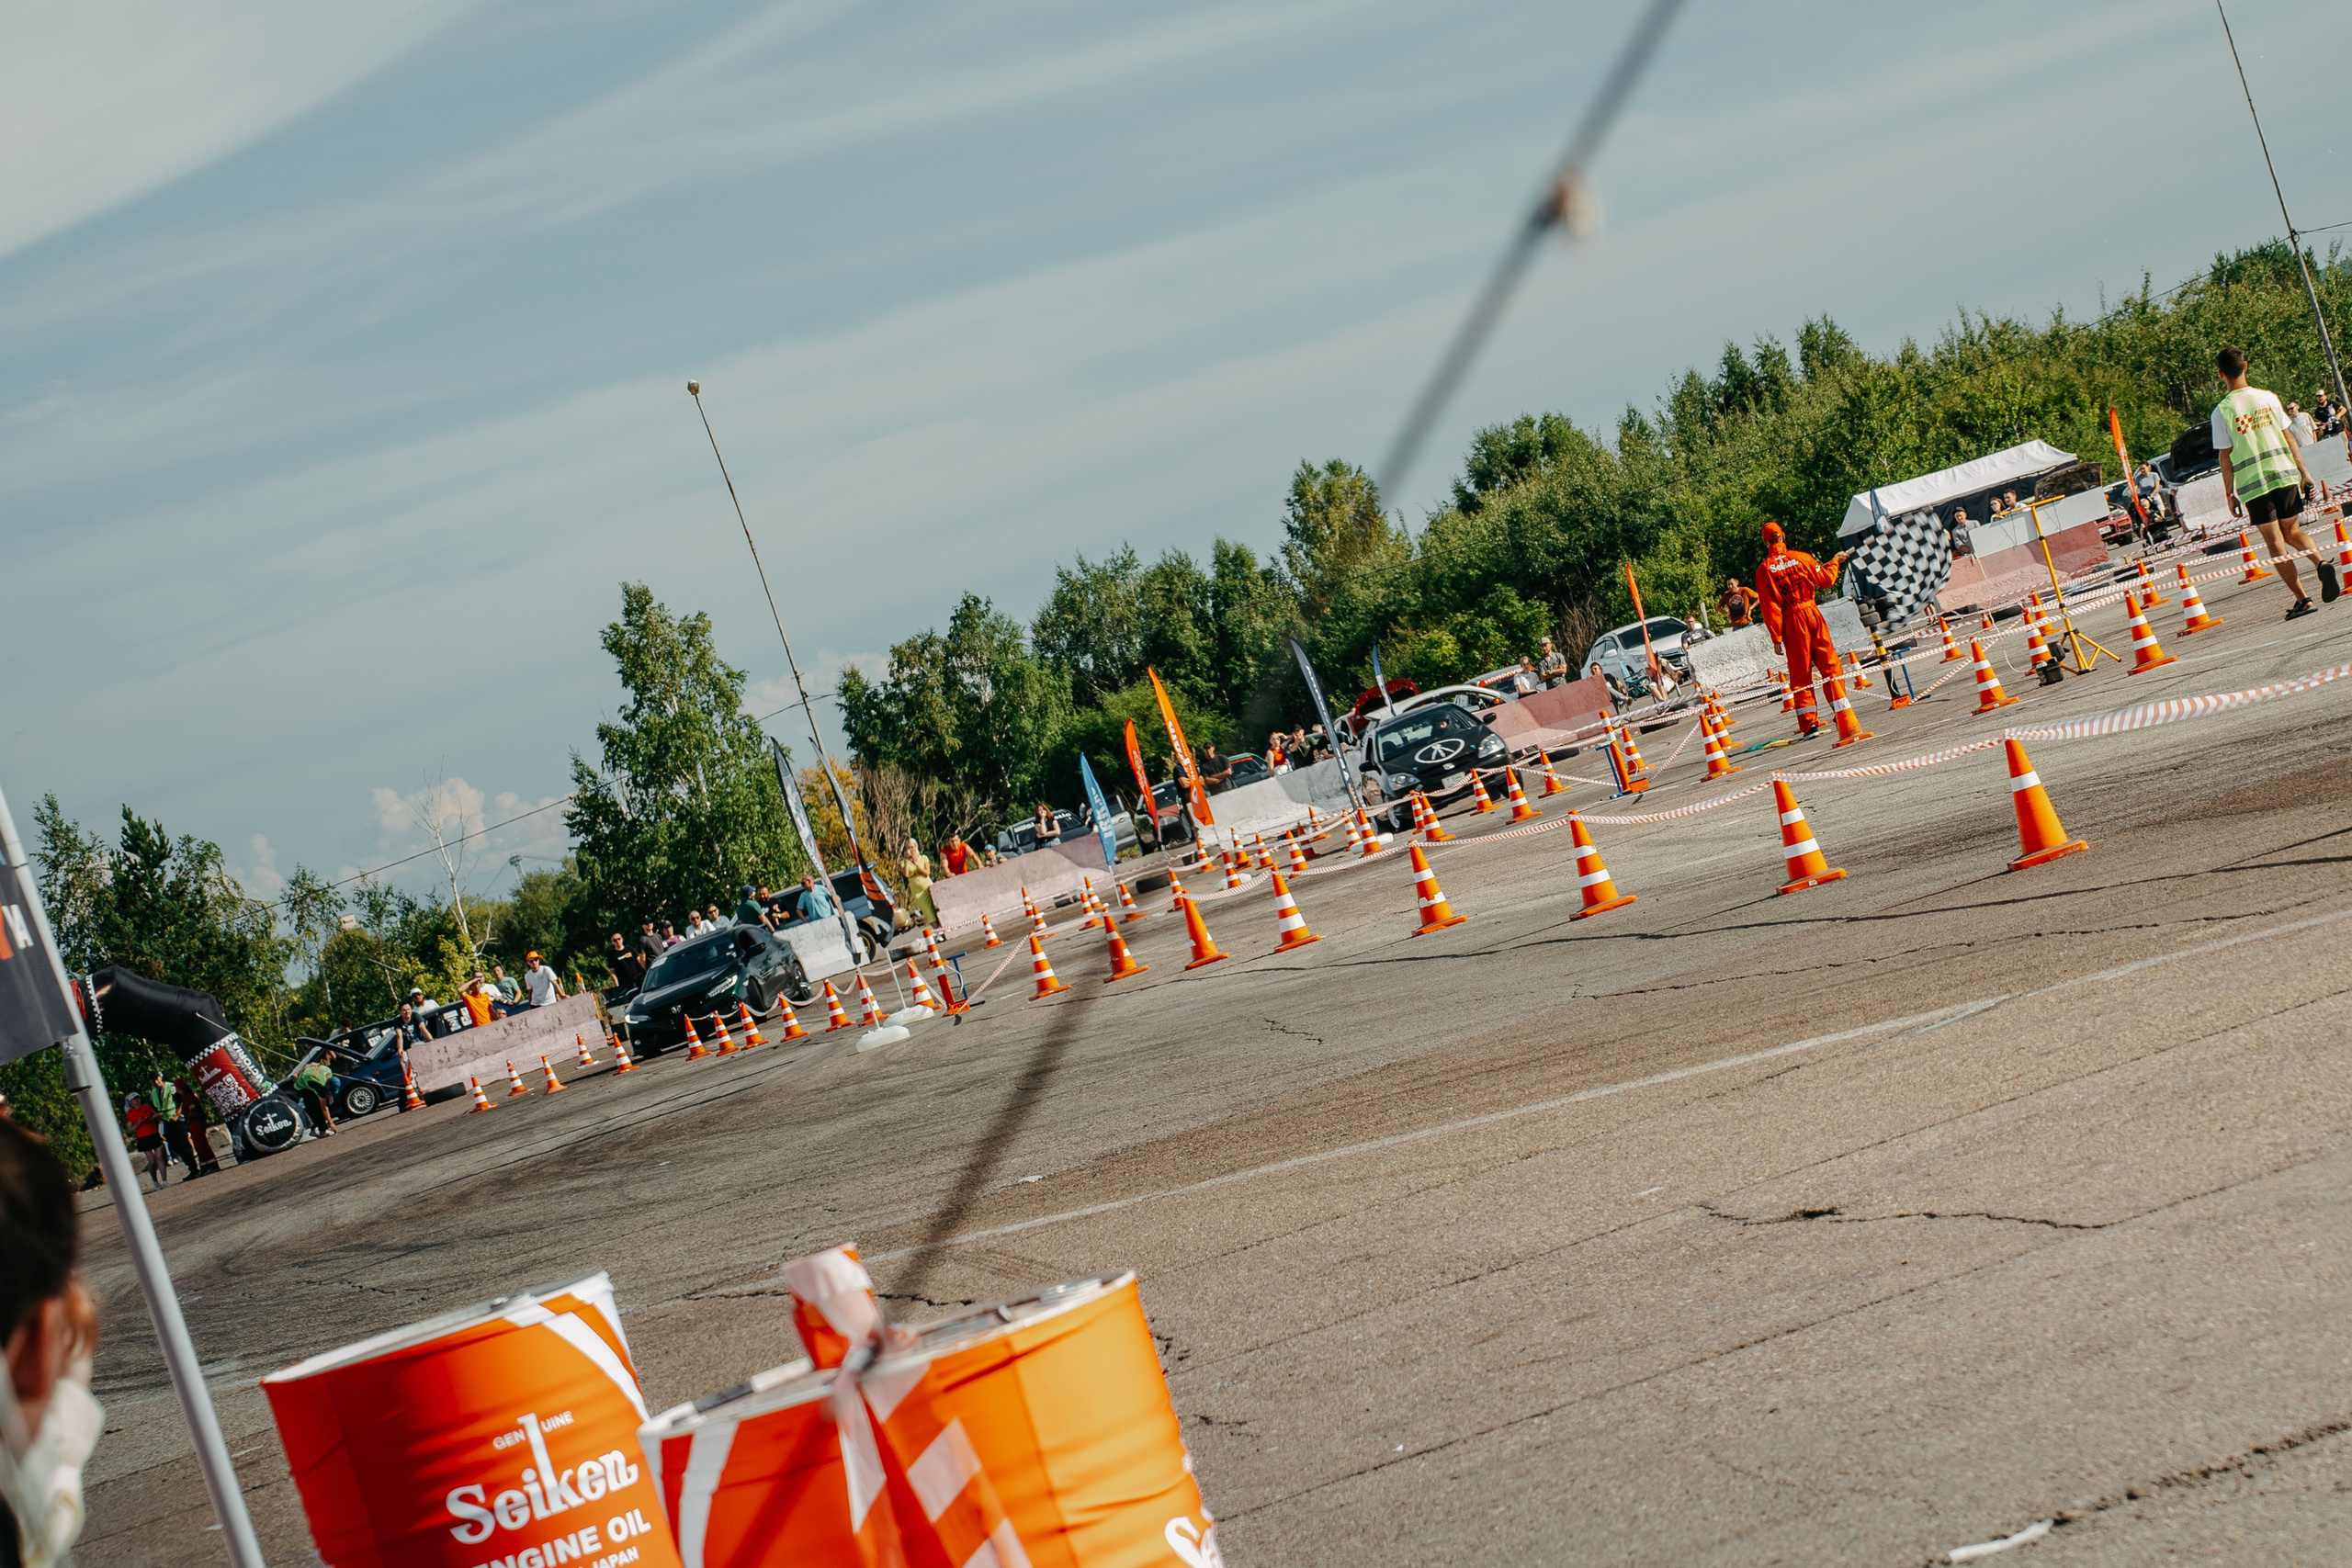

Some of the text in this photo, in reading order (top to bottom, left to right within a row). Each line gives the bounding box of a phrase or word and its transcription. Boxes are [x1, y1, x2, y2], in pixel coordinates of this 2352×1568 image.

[232, 1041, 265, 1084] VICTORIA
[255, 1113, 292, 1136] Seiken
[446, 1412, 639, 1545] Seiken
[471, 1507, 652, 1568] GINE OIL
